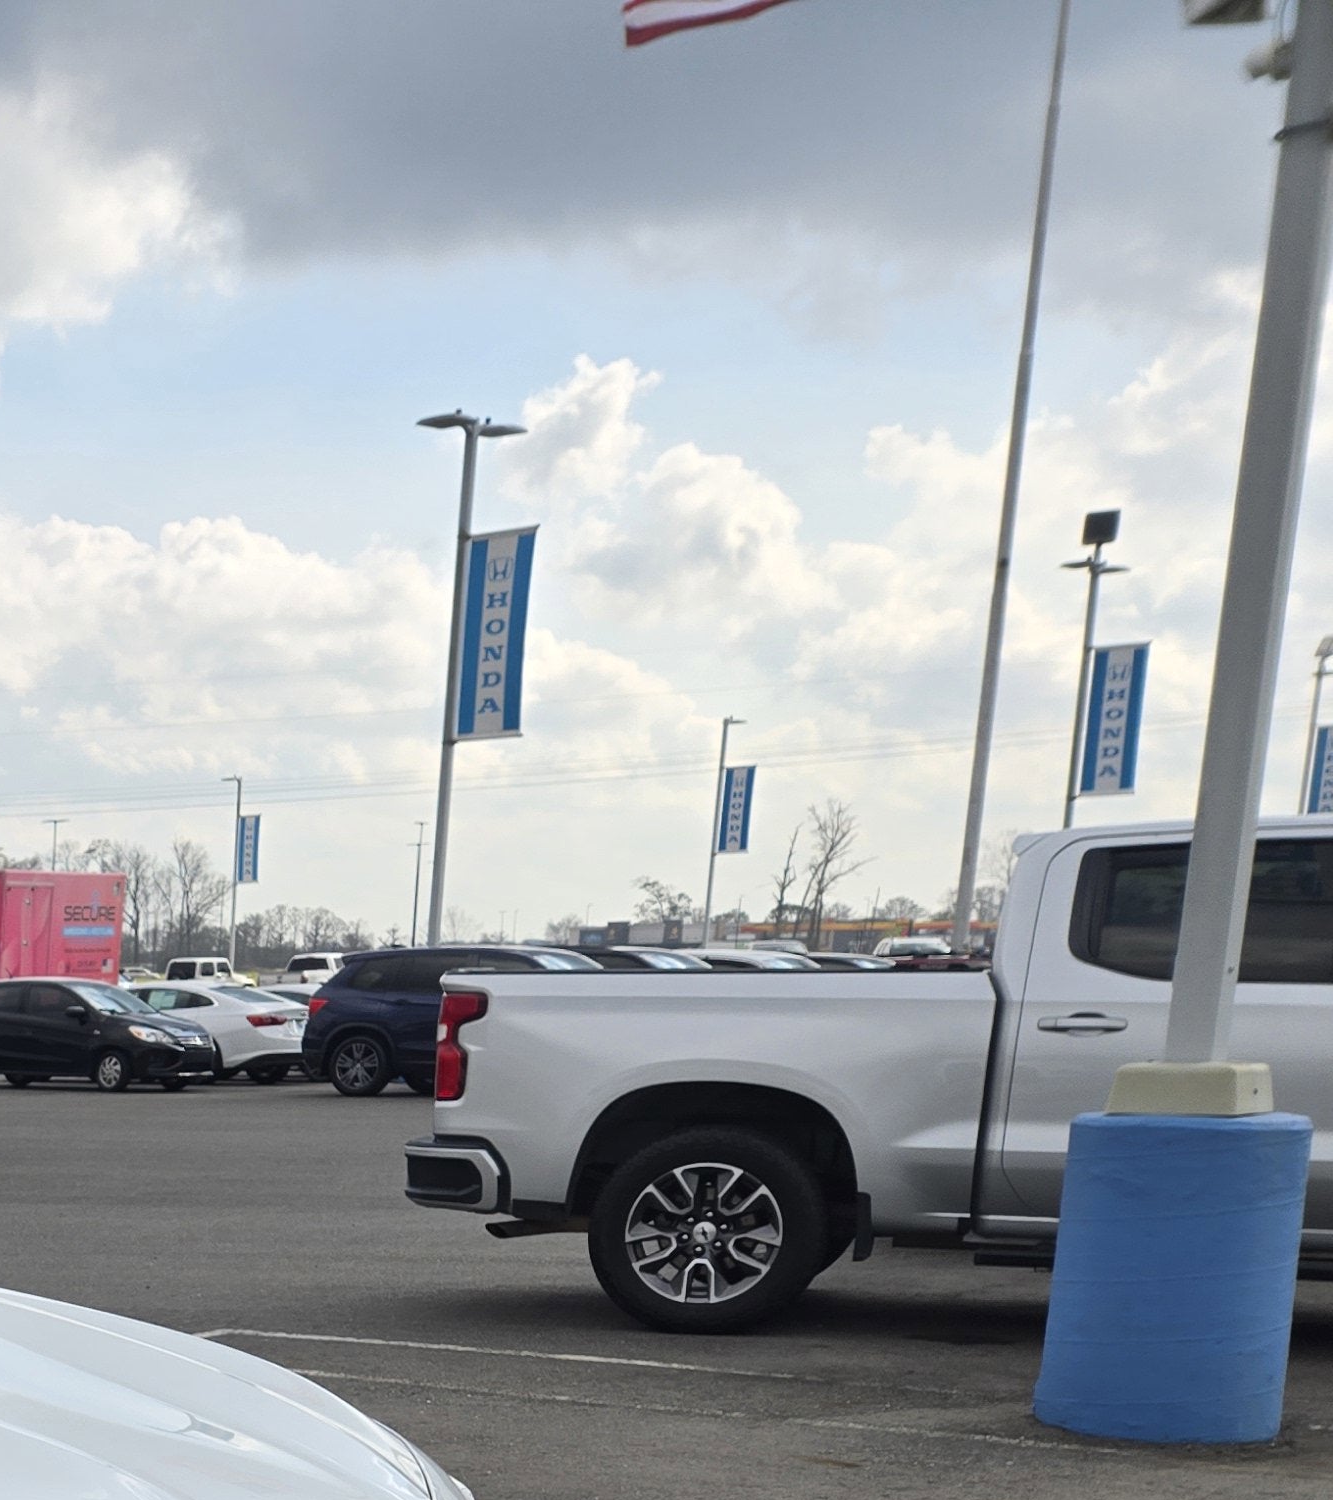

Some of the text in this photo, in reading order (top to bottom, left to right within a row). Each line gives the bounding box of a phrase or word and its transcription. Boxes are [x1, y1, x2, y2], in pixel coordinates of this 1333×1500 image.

[477, 591, 509, 714] HONDA
[1098, 688, 1126, 778] HONDA
[63, 905, 116, 922] SECURE
